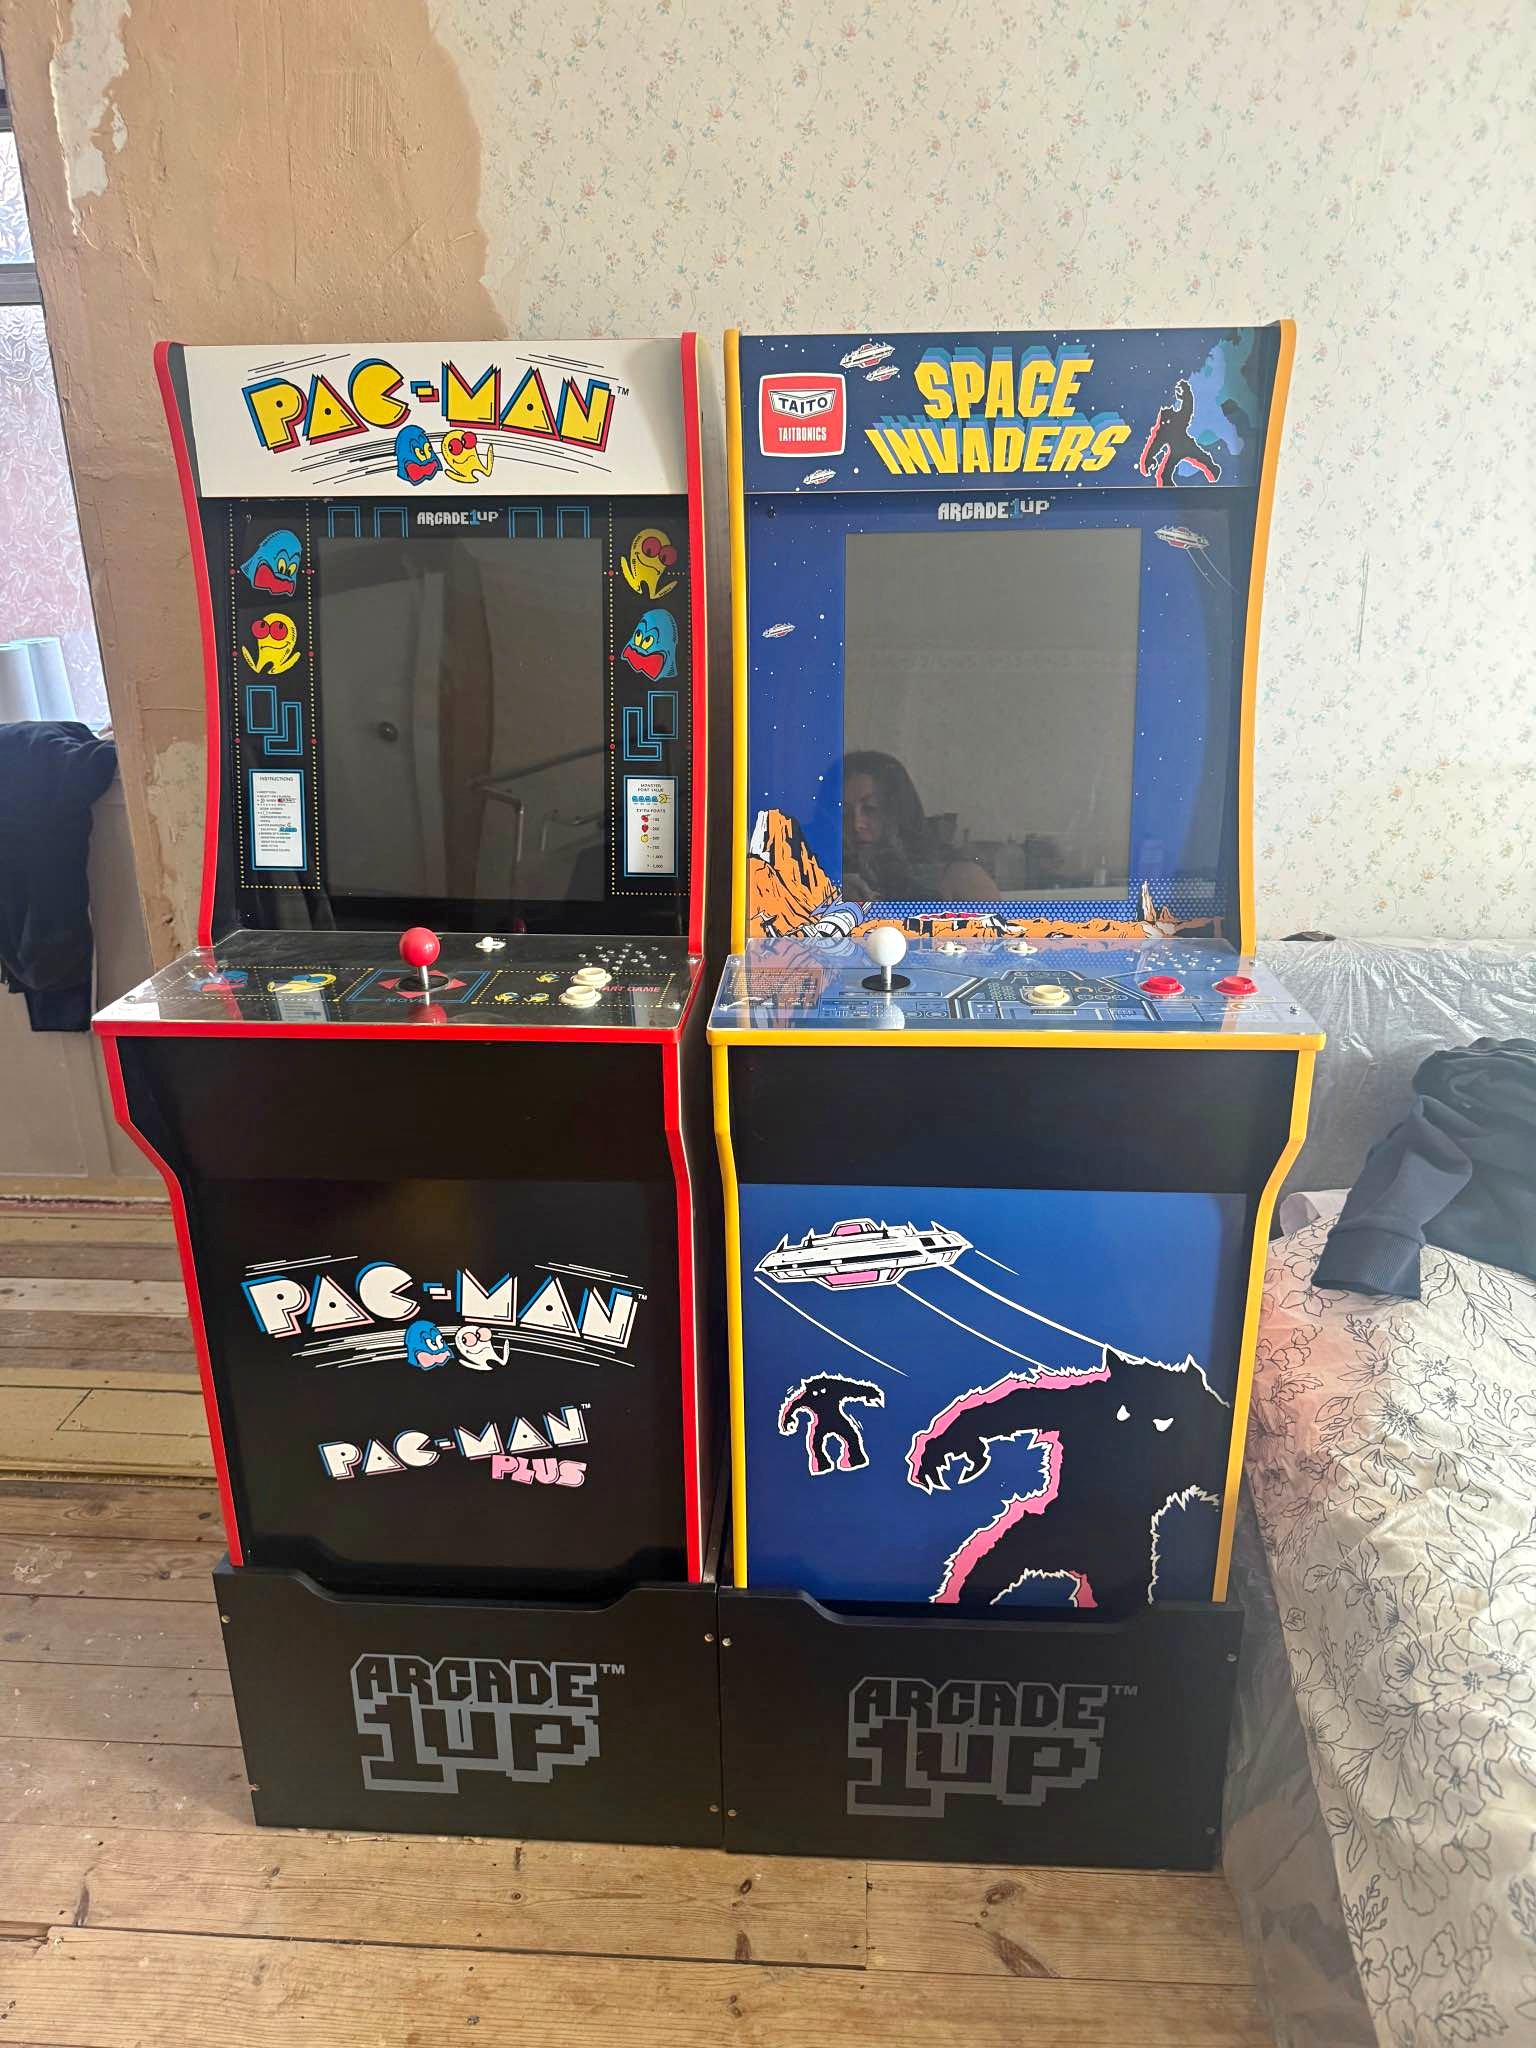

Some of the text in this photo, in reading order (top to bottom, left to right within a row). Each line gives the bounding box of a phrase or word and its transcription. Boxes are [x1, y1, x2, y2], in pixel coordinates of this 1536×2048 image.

[241, 358, 615, 454] PAC-MAN
[778, 396, 828, 414] TAITO
[914, 345, 1094, 419] SPACE
[778, 426, 827, 442] TAITRONICS
[864, 412, 1132, 475] INVADERS
[241, 1261, 638, 1349] PAC-MAN
[317, 1406, 589, 1481] PAC-MAN
[491, 1454, 588, 1488] PLUS
[351, 1653, 599, 1708] ARCADE
[850, 1676, 1108, 1732] ARCADE
[358, 1694, 600, 1794] 1UP
[847, 1717, 1101, 1818] 1UP
